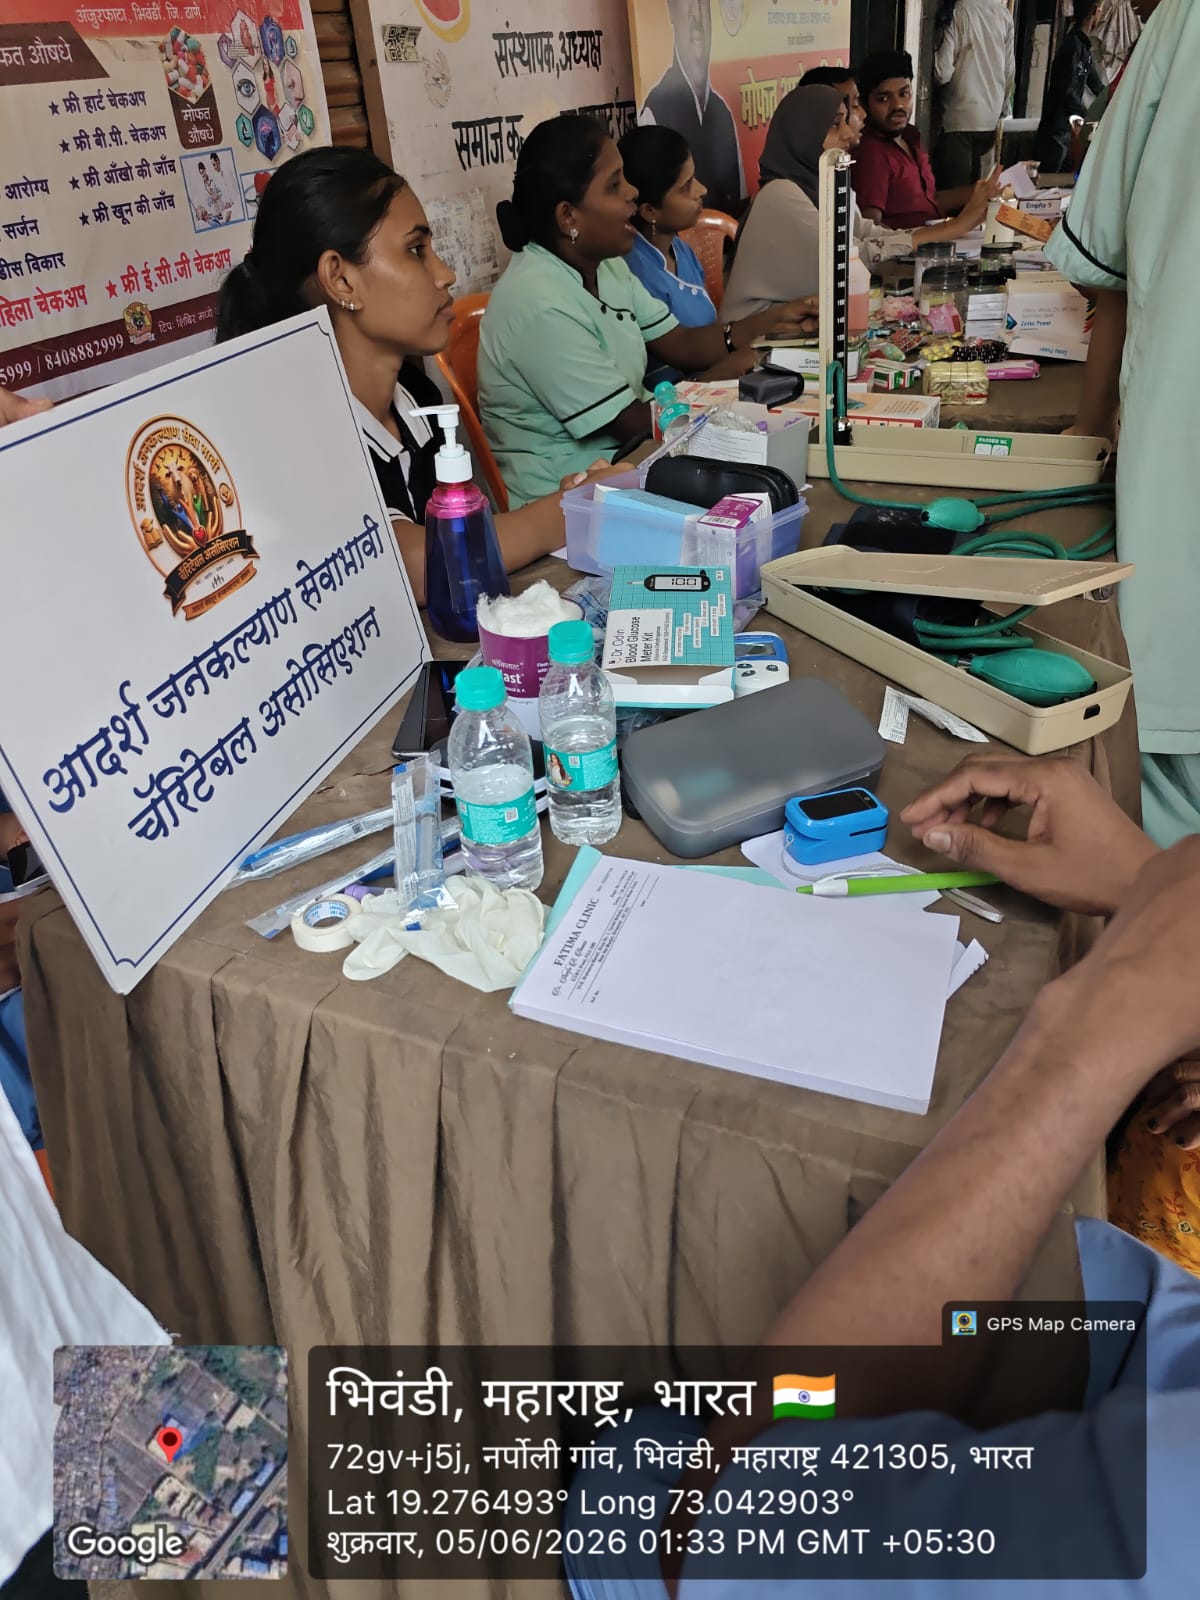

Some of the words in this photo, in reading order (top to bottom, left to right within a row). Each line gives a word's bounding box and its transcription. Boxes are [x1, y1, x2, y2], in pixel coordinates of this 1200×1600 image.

[0, 45, 25, 66] फत
[29, 36, 73, 65] औषधे
[63, 90, 79, 114] फ्री
[85, 88, 105, 113] हार्ट
[107, 88, 147, 111] चेकअप
[181, 104, 211, 122] मोफत
[73, 129, 91, 151] फ्री
[93, 125, 128, 149] बी.पी.
[129, 123, 167, 143] चेकअप
[187, 124, 214, 144] औषधे
[452, 116, 503, 171] समाज
[83, 166, 101, 188] फ्री
[135, 159, 151, 180] की
[5, 176, 50, 199] आरोग्य
[92, 201, 109, 224] फ्री
[111, 203, 133, 226] खून
[135, 195, 151, 215] की
[2, 215, 40, 240] सर्जन
[25, 252, 66, 274] विकार
[120, 264, 141, 294] फ्री
[193, 248, 232, 275] चेकअप
[0, 295, 34, 327] हिला
[34, 284, 88, 314] चेकअप
[0, 360, 32, 386] 5999
[44, 334, 124, 370] 8408882999
[612, 629, 625, 647] Odin
[627, 616, 641, 642] Glucose
[642, 631, 653, 642] Kit
[42, 679, 150, 813] आदर्श
[146, 587, 298, 719] जनकल्याण
[295, 513, 385, 612] सेवाभावी
[625, 643, 638, 663] Blood
[640, 642, 653, 662] Meter
[259, 605, 382, 737] असोसिएशन
[504, 673, 522, 685] ast
[553, 930, 582, 967] FATIMA
[576, 898, 600, 930] CLINIC
